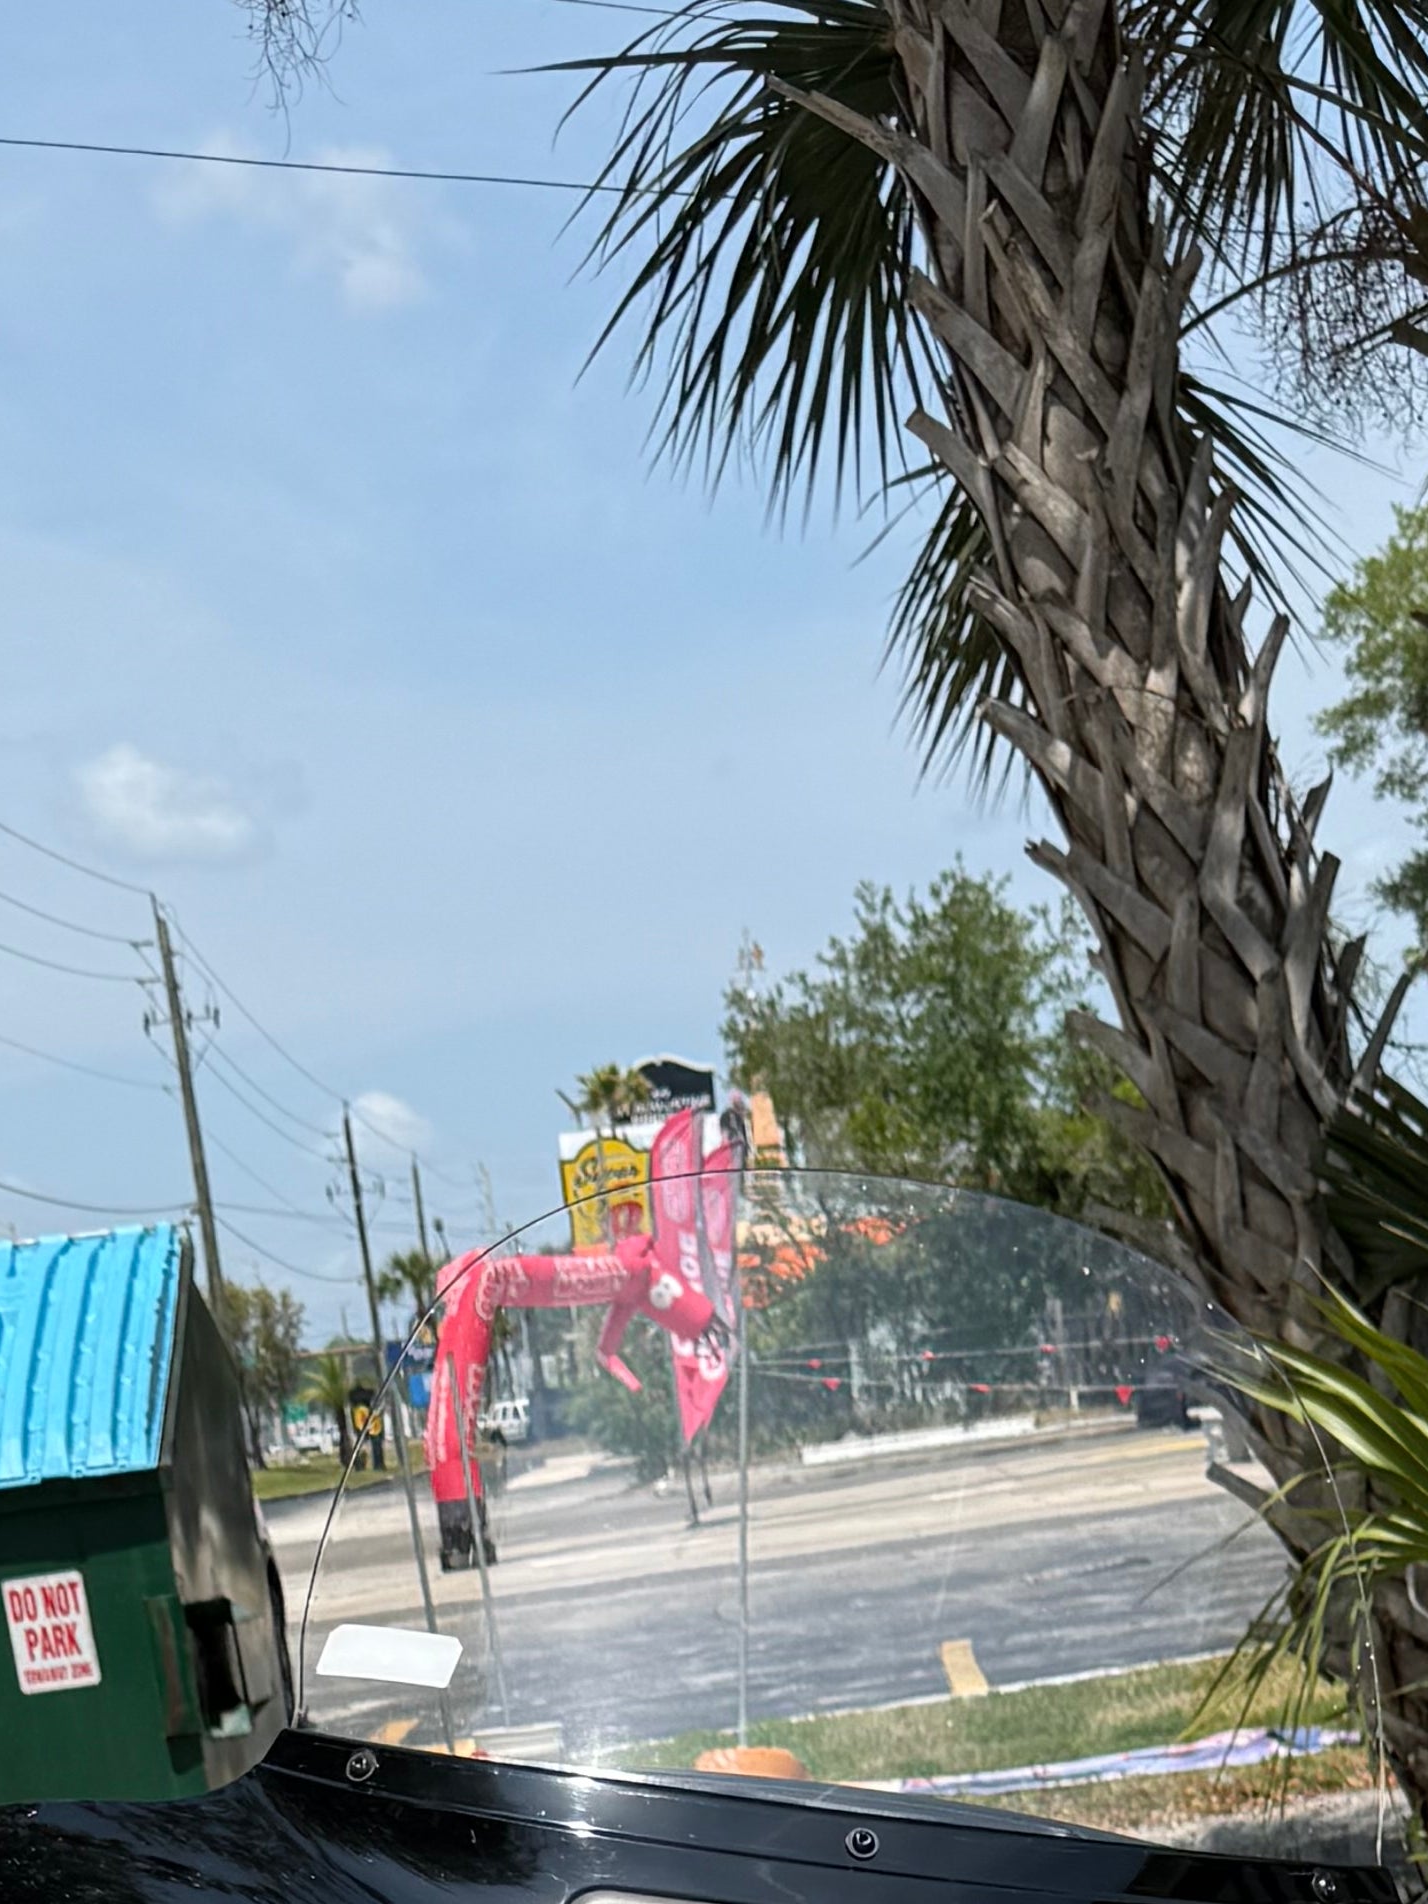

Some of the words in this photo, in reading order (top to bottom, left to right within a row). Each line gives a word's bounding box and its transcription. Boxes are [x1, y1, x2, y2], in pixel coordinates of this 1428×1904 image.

[9, 1587, 38, 1623] DO
[41, 1581, 80, 1618] NOT
[25, 1622, 82, 1662] PARK
